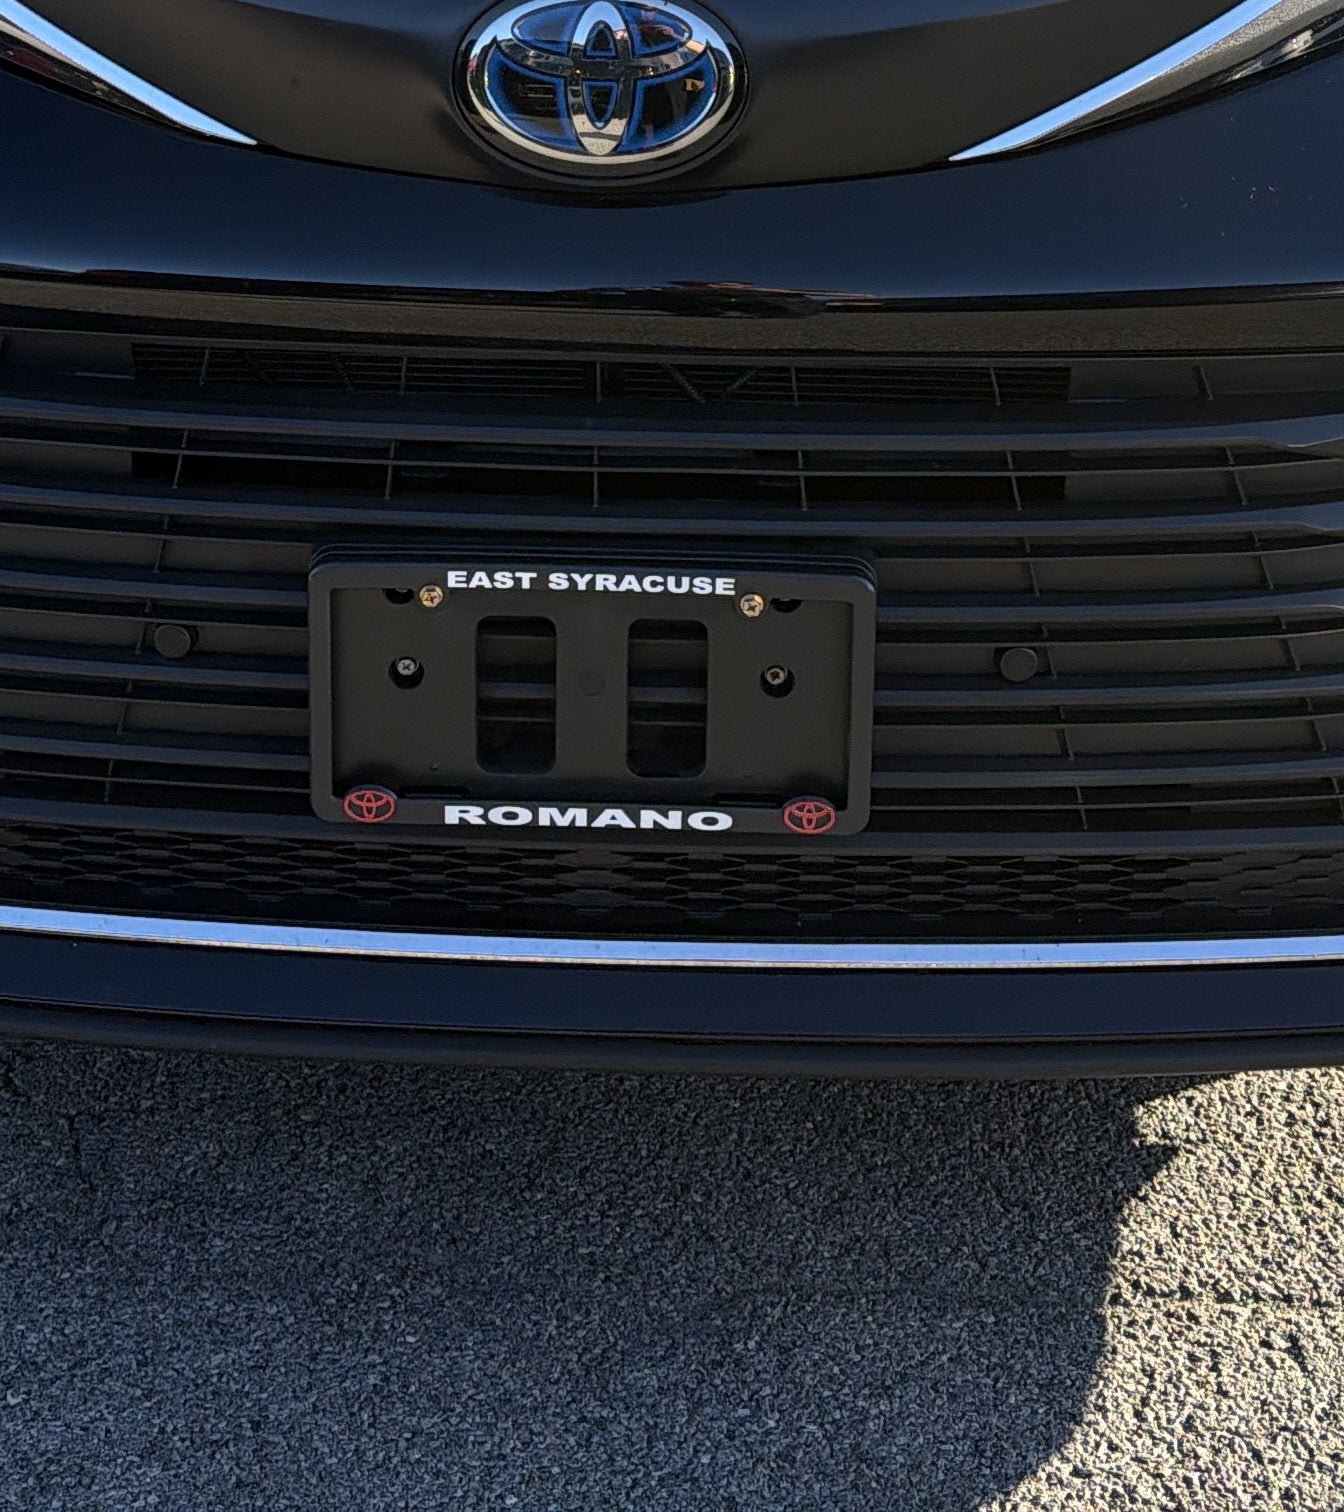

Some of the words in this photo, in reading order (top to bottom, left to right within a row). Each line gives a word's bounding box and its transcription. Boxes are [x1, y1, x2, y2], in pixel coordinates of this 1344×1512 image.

[447, 570, 537, 589] EAST
[548, 572, 736, 596] SYRACUSE
[444, 804, 733, 831] ROMANO
